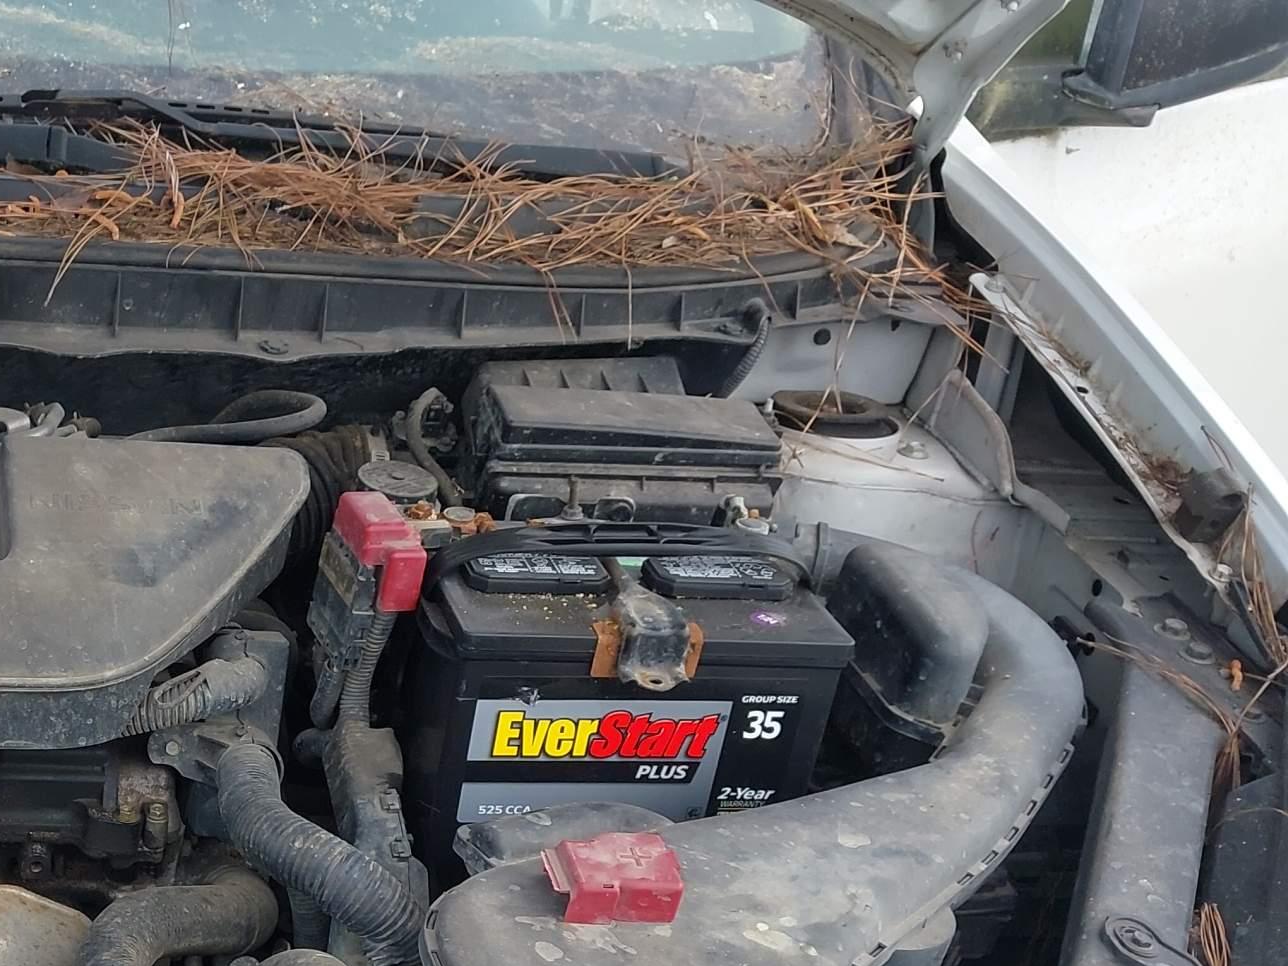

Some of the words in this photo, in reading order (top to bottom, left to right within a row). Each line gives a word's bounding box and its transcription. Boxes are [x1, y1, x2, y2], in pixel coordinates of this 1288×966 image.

[741, 695, 776, 704] GROUP
[777, 695, 799, 704] SIZE
[742, 710, 785, 739] 35
[491, 709, 721, 759] EverStart
[635, 765, 689, 779] PLUS
[717, 787, 775, 800] 2-Year
[477, 805, 504, 815] 525
[505, 805, 532, 815] CCA
